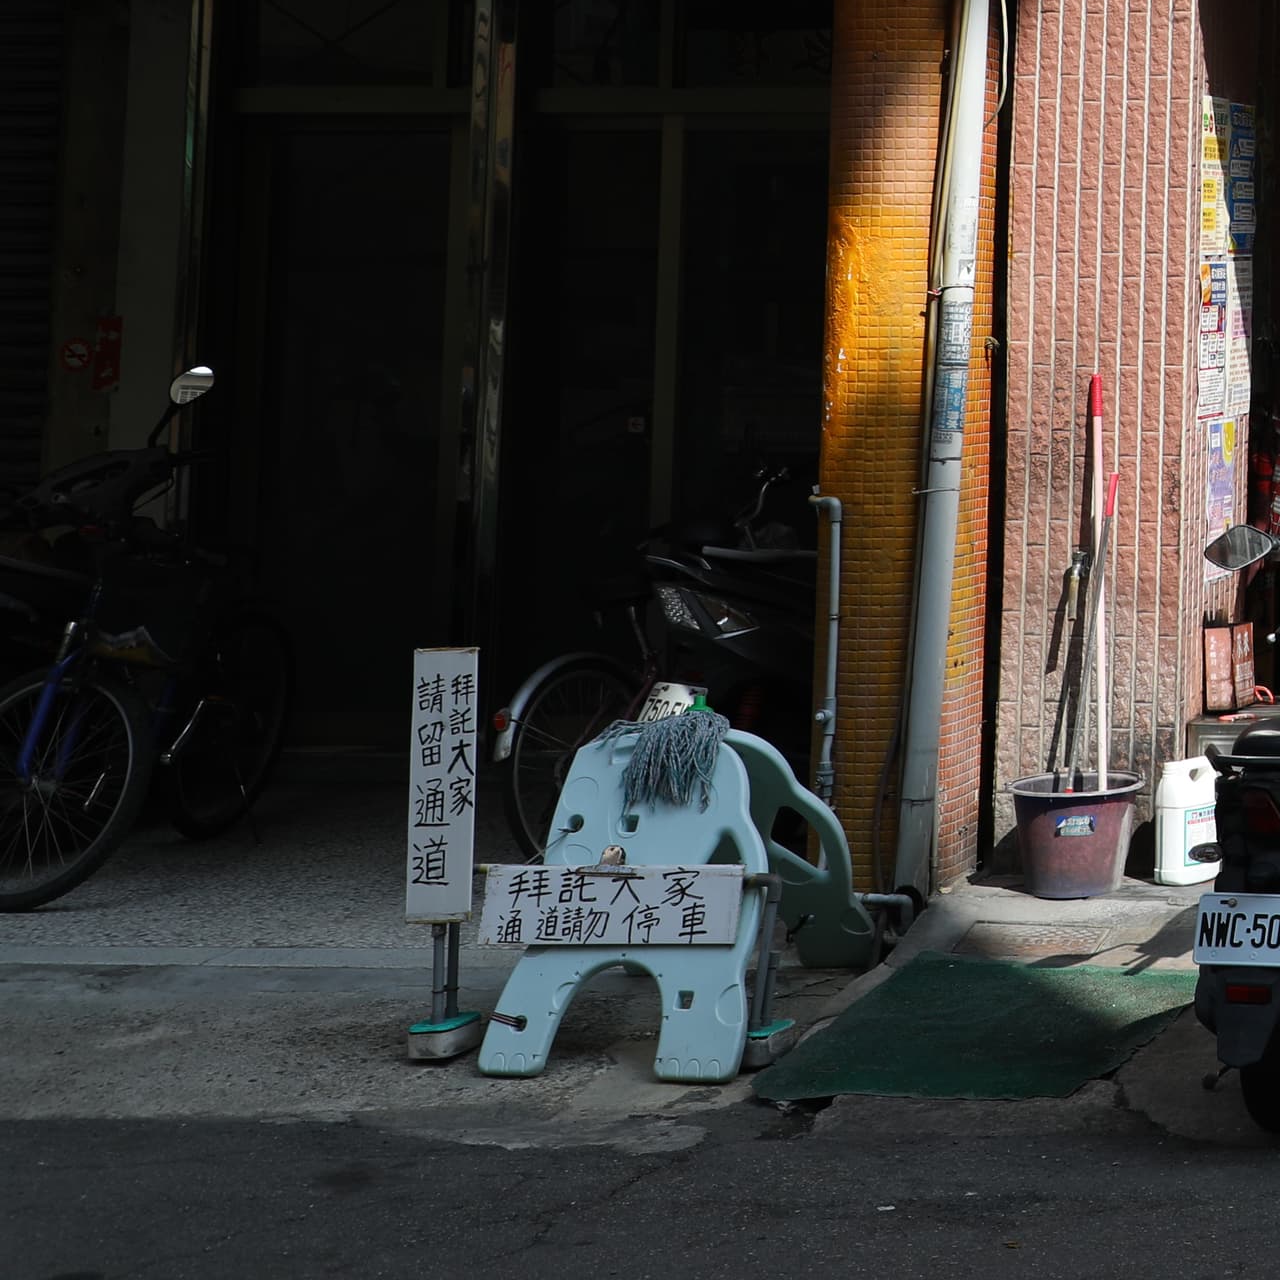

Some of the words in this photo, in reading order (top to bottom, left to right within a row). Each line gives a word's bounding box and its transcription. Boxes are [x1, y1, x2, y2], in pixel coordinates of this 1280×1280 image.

[412, 674, 450, 887] 請留通道
[447, 673, 476, 816] 拜託大家
[497, 902, 708, 945] 通道請勿停車
[508, 869, 704, 908] 拜託大家
